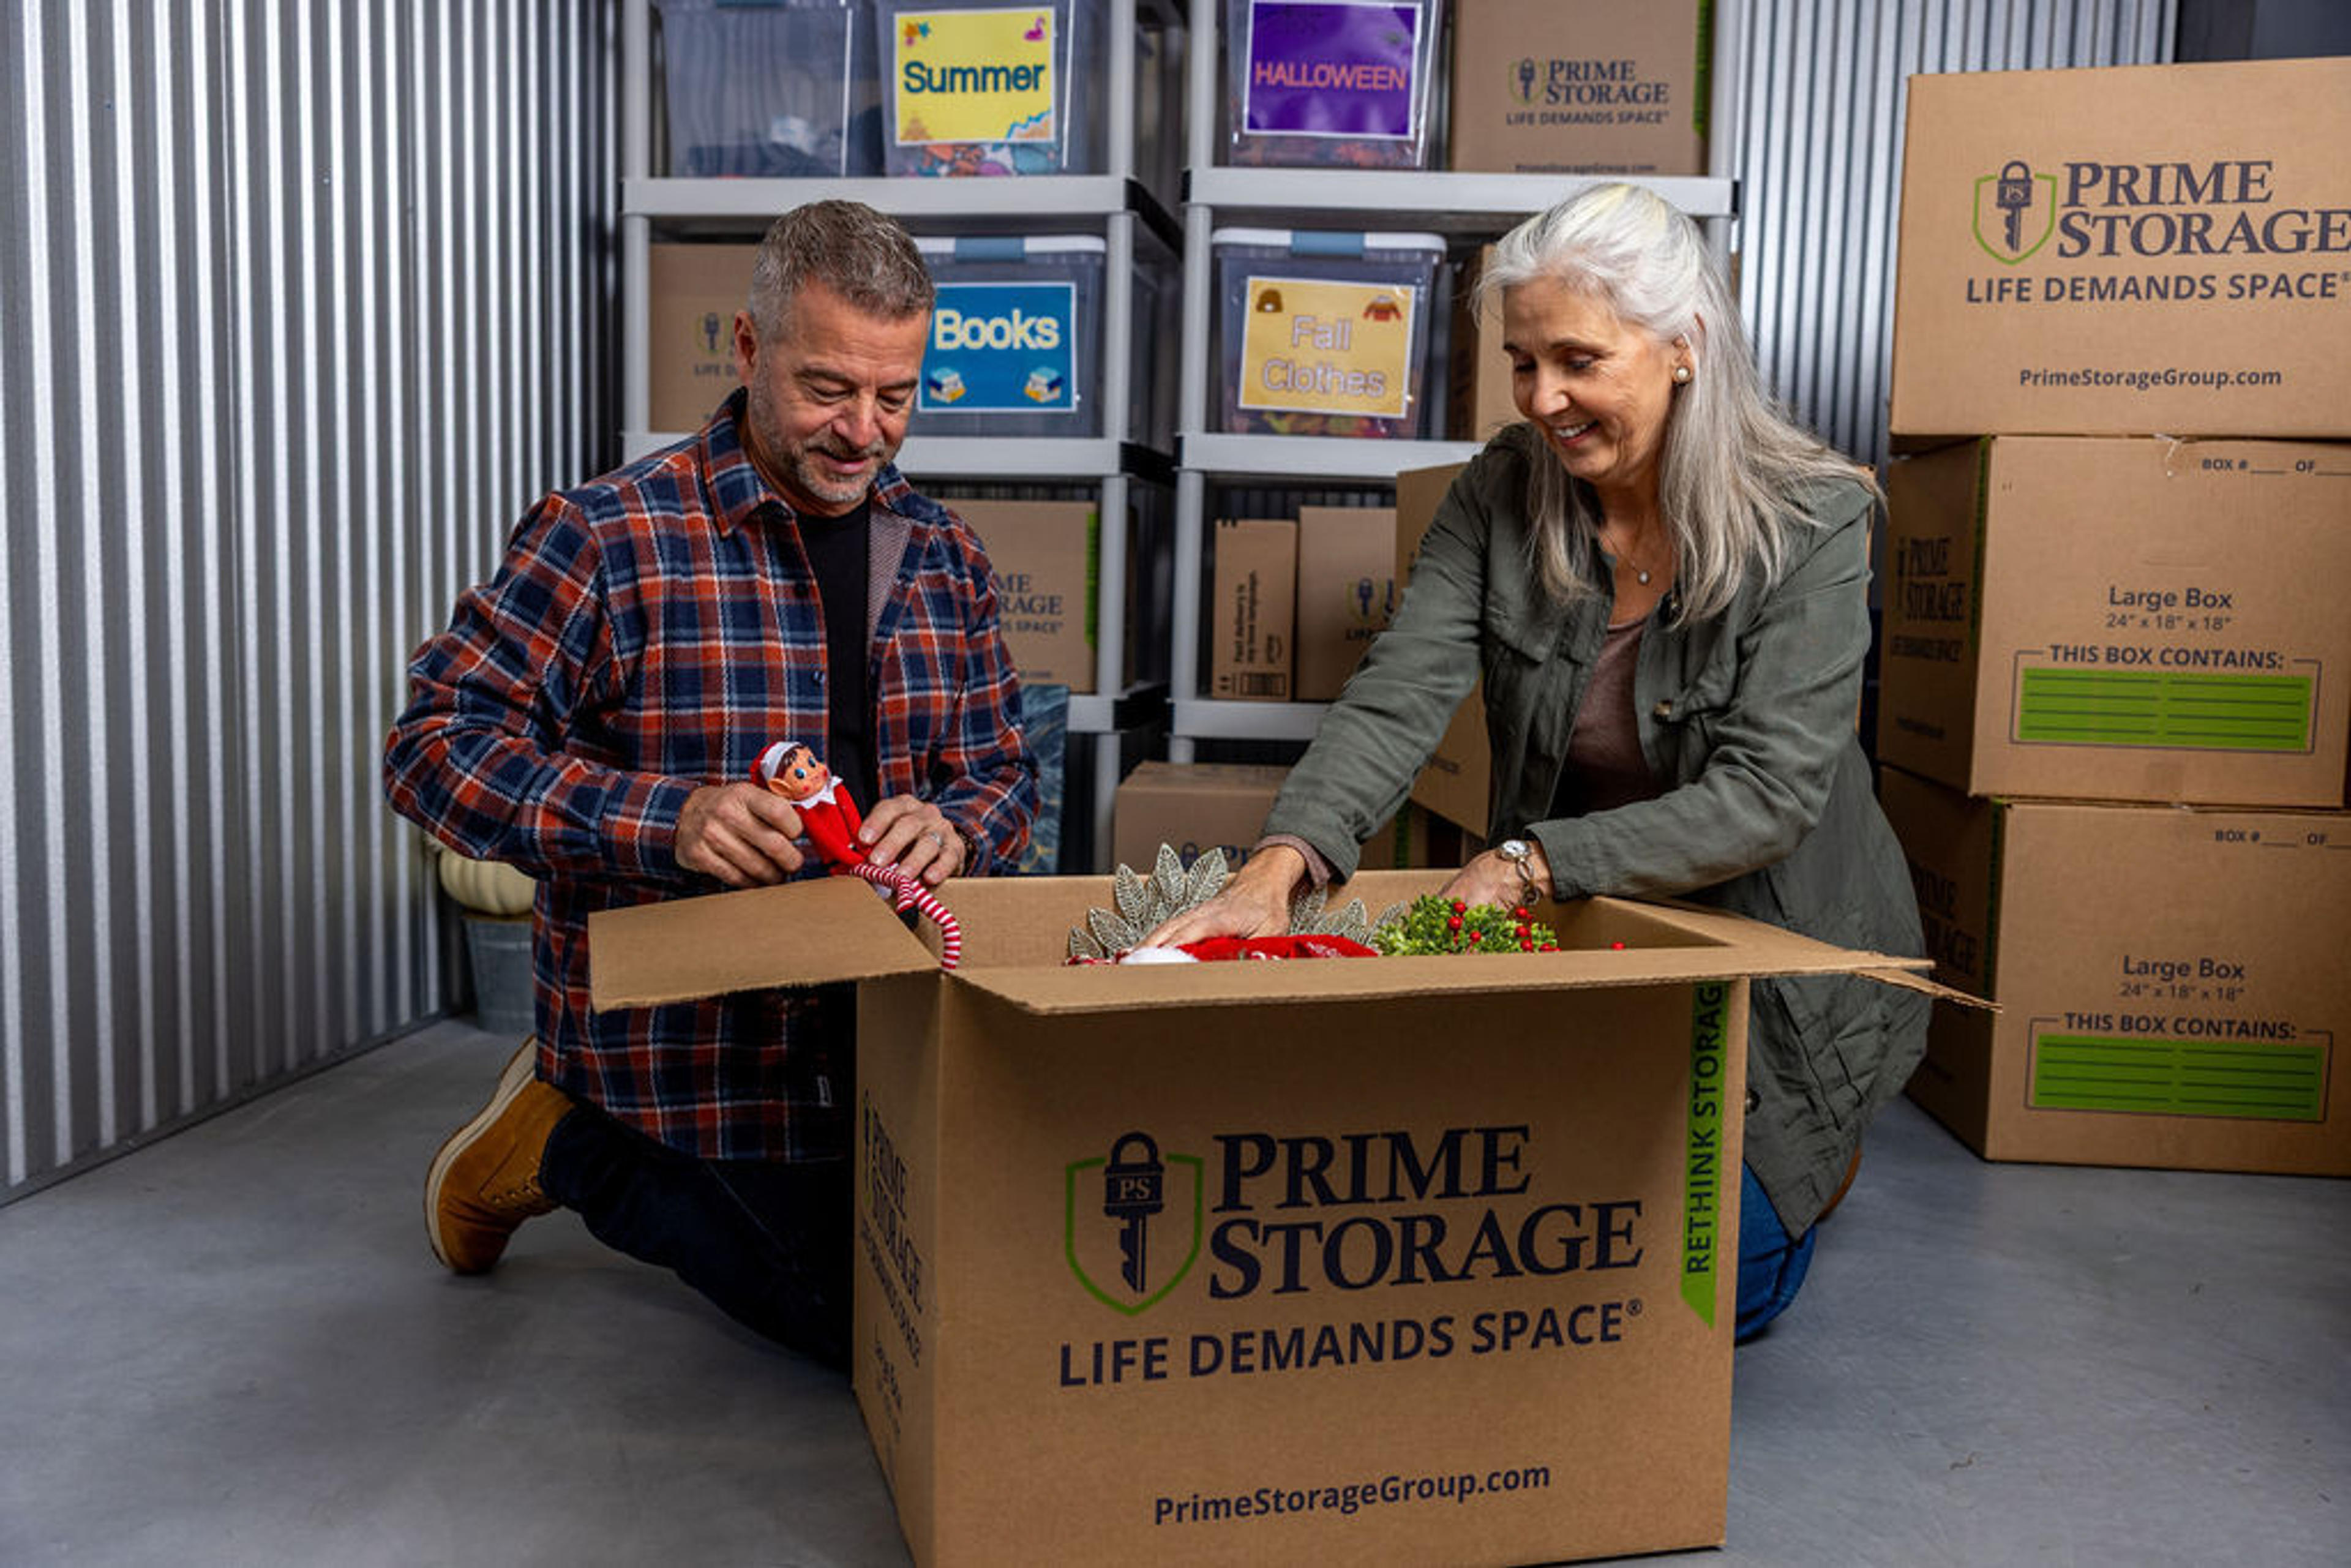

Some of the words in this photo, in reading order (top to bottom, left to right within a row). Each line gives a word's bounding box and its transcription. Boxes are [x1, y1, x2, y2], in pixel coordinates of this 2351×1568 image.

[904, 61, 1046, 94] Summer
[1255, 62, 1407, 91] HALLOWEEN
[1549, 59, 1636, 81] PRIME
[1545, 82, 1670, 105] STORAGE
[1506, 111, 1535, 126] LIFE
[1540, 111, 1614, 125] DEMANDS
[2061, 160, 2273, 208] PRIME
[2057, 209, 2351, 258] STORAGE
[1967, 277, 2033, 303] LIFE
[2044, 274, 2217, 302] DEMANDS
[934, 309, 1060, 350] Books
[1292, 315, 1351, 351] Fall
[1263, 360, 1385, 399] Clothes
[2020, 369, 2282, 391] PrimeStorageGroup.com
[2202, 459, 2233, 470] BOX
[2296, 460, 2315, 472] OF
[998, 594, 1065, 615] RAGE
[2109, 586, 2178, 612] Large
[2186, 588, 2232, 609] Box
[2105, 614, 2135, 628] 24"
[2156, 615, 2184, 629] 18"
[2205, 616, 2232, 631] 18"
[2050, 645, 2099, 663] THIS
[2105, 647, 2153, 665] BOX
[2159, 648, 2285, 670] CONTAINS:
[2215, 830, 2246, 842] BOX
[2123, 955, 2191, 981] Large
[2199, 958, 2245, 980] Box
[2064, 1012, 2113, 1031] THIS
[2121, 1014, 2167, 1033] BOX
[2173, 1017, 2297, 1040] CONTAINS:
[1692, 985, 1723, 1118] STORAG
[1212, 1124, 1532, 1214] PRIME
[1119, 1178, 1152, 1201] PS
[1687, 1128, 1715, 1274] RETHINK
[1207, 1200, 1644, 1300] STORAGE
[1059, 1338, 1168, 1388] LIFE
[1190, 1315, 1455, 1378] DEMANDS
[1154, 1467, 1551, 1526] PrimeStorageGroup.com
